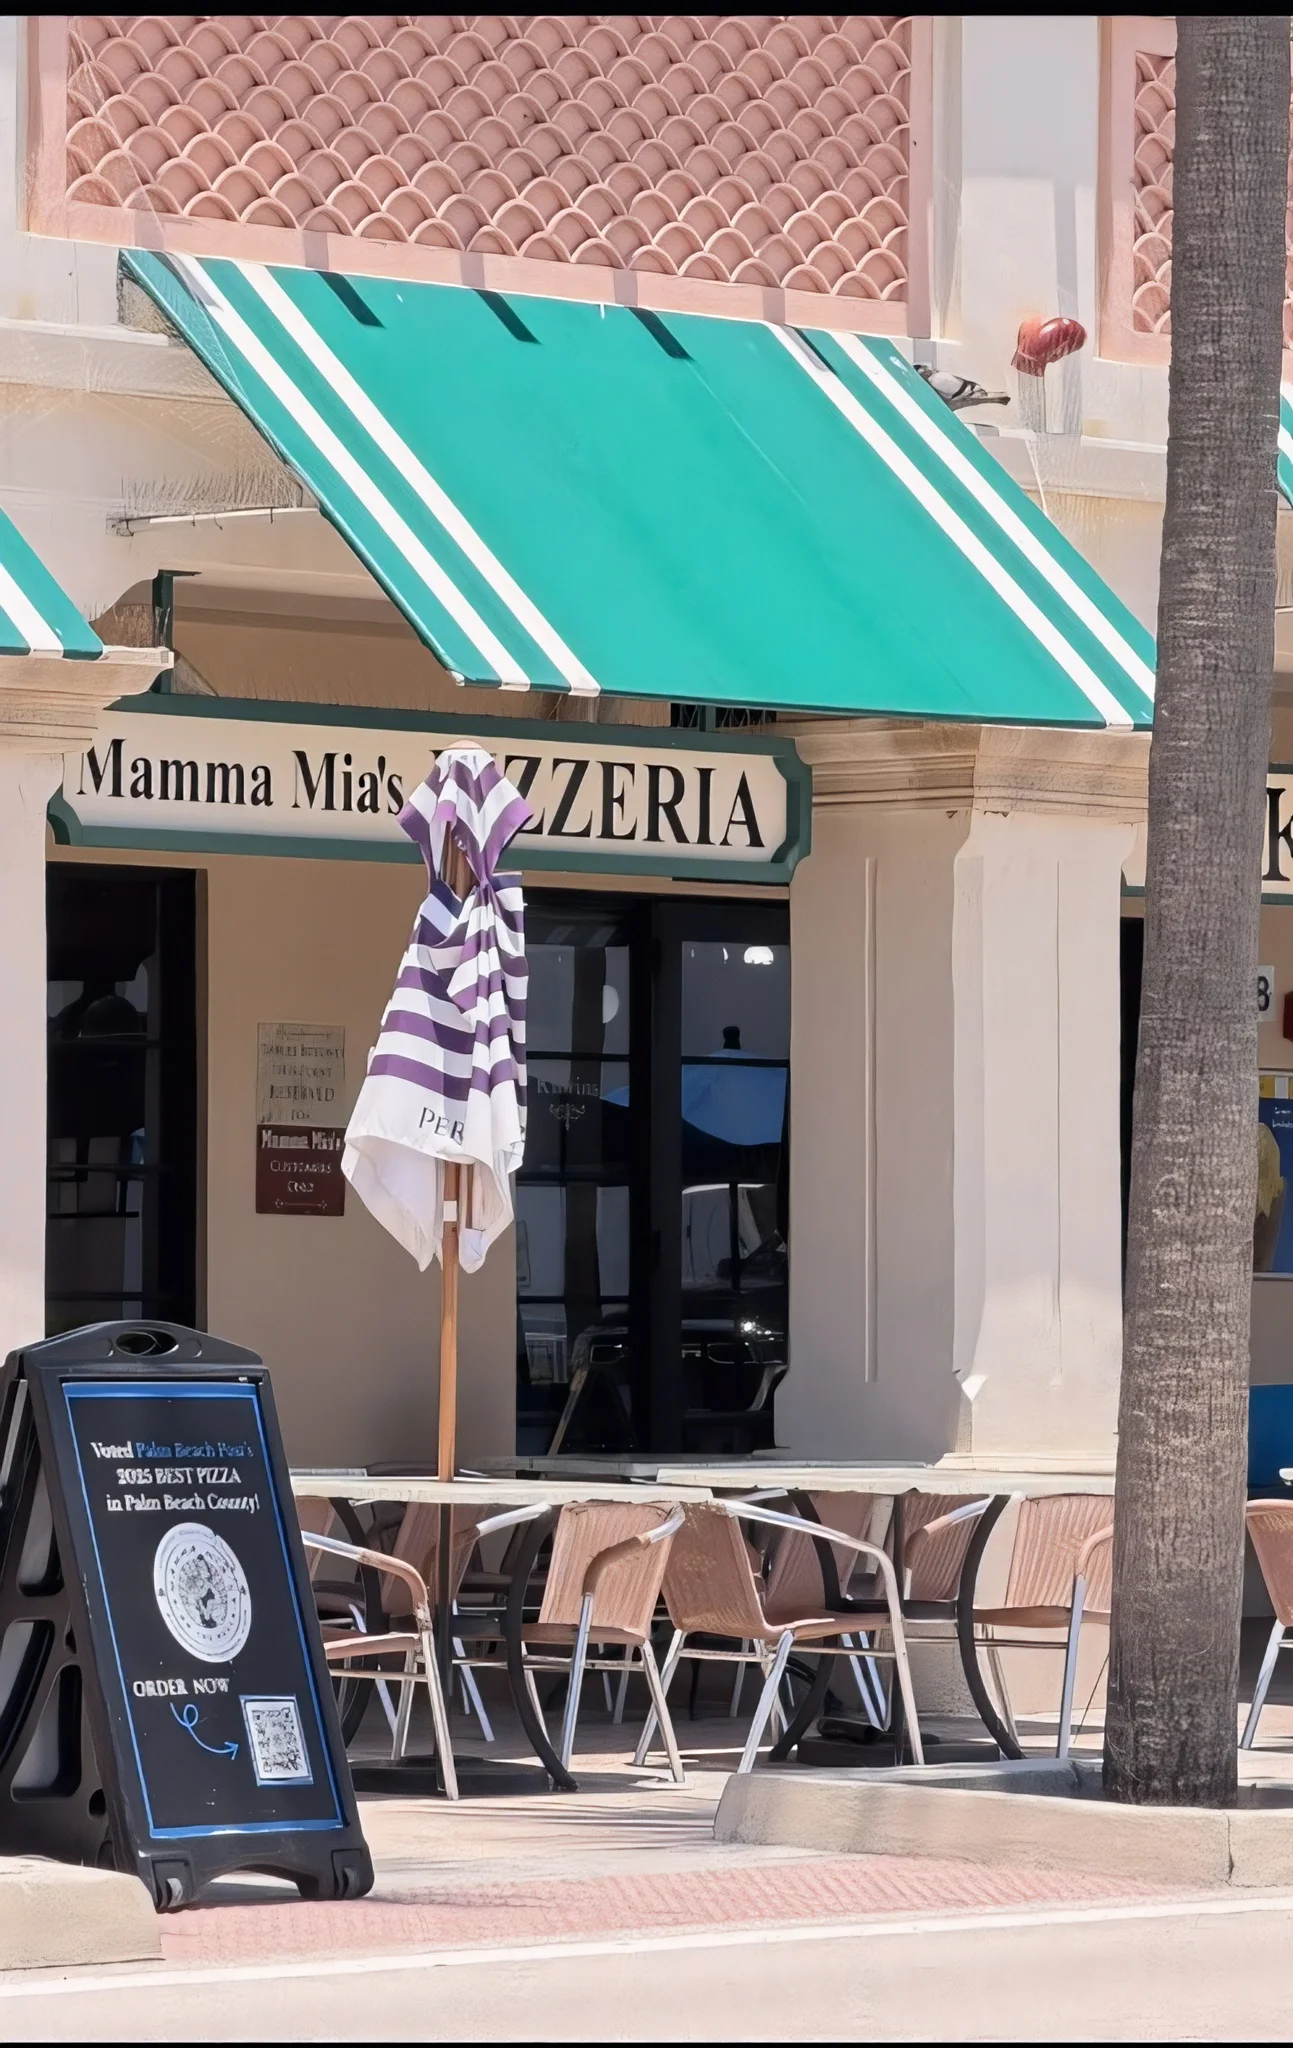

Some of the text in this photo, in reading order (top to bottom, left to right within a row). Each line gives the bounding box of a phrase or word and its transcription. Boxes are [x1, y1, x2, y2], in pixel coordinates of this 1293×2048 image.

[76, 738, 766, 848] Mamma Mia's ZZERIA
[90, 1440, 134, 1459] Voted
[136, 1442, 172, 1459] Palm
[174, 1441, 216, 1459] Beach
[154, 1467, 194, 1485] BEST
[196, 1466, 242, 1484] PIZZA
[106, 1493, 123, 1512] in
[124, 1493, 162, 1512] Palm
[163, 1492, 206, 1511] Beach
[132, 1677, 230, 1698] ORDER NOW
